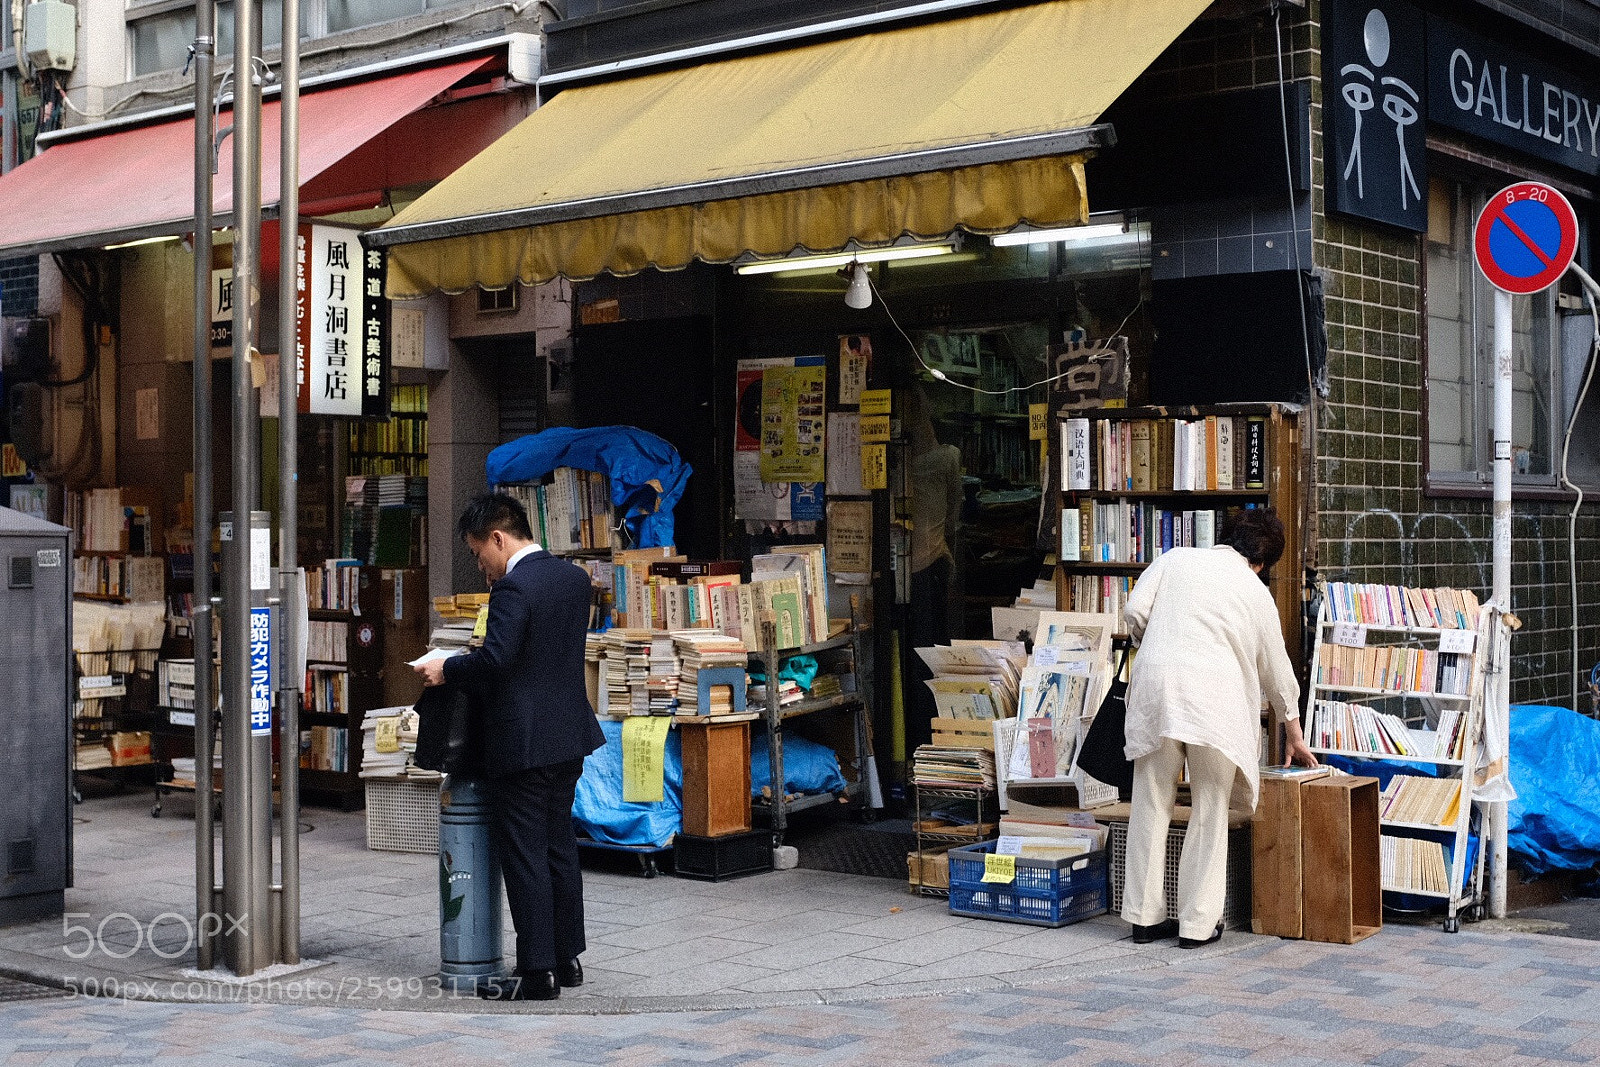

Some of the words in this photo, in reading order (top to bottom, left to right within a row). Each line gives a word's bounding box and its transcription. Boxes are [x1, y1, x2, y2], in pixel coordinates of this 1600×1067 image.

[1449, 48, 1600, 157] GALLERY
[1505, 187, 1548, 204] 8-20
[325, 239, 350, 400] 風月洞書店
[366, 250, 381, 396] 茶道・古美術書
[1075, 428, 1085, 480] 汉语大词典
[250, 613, 270, 727] 防犯カメラ作動中
